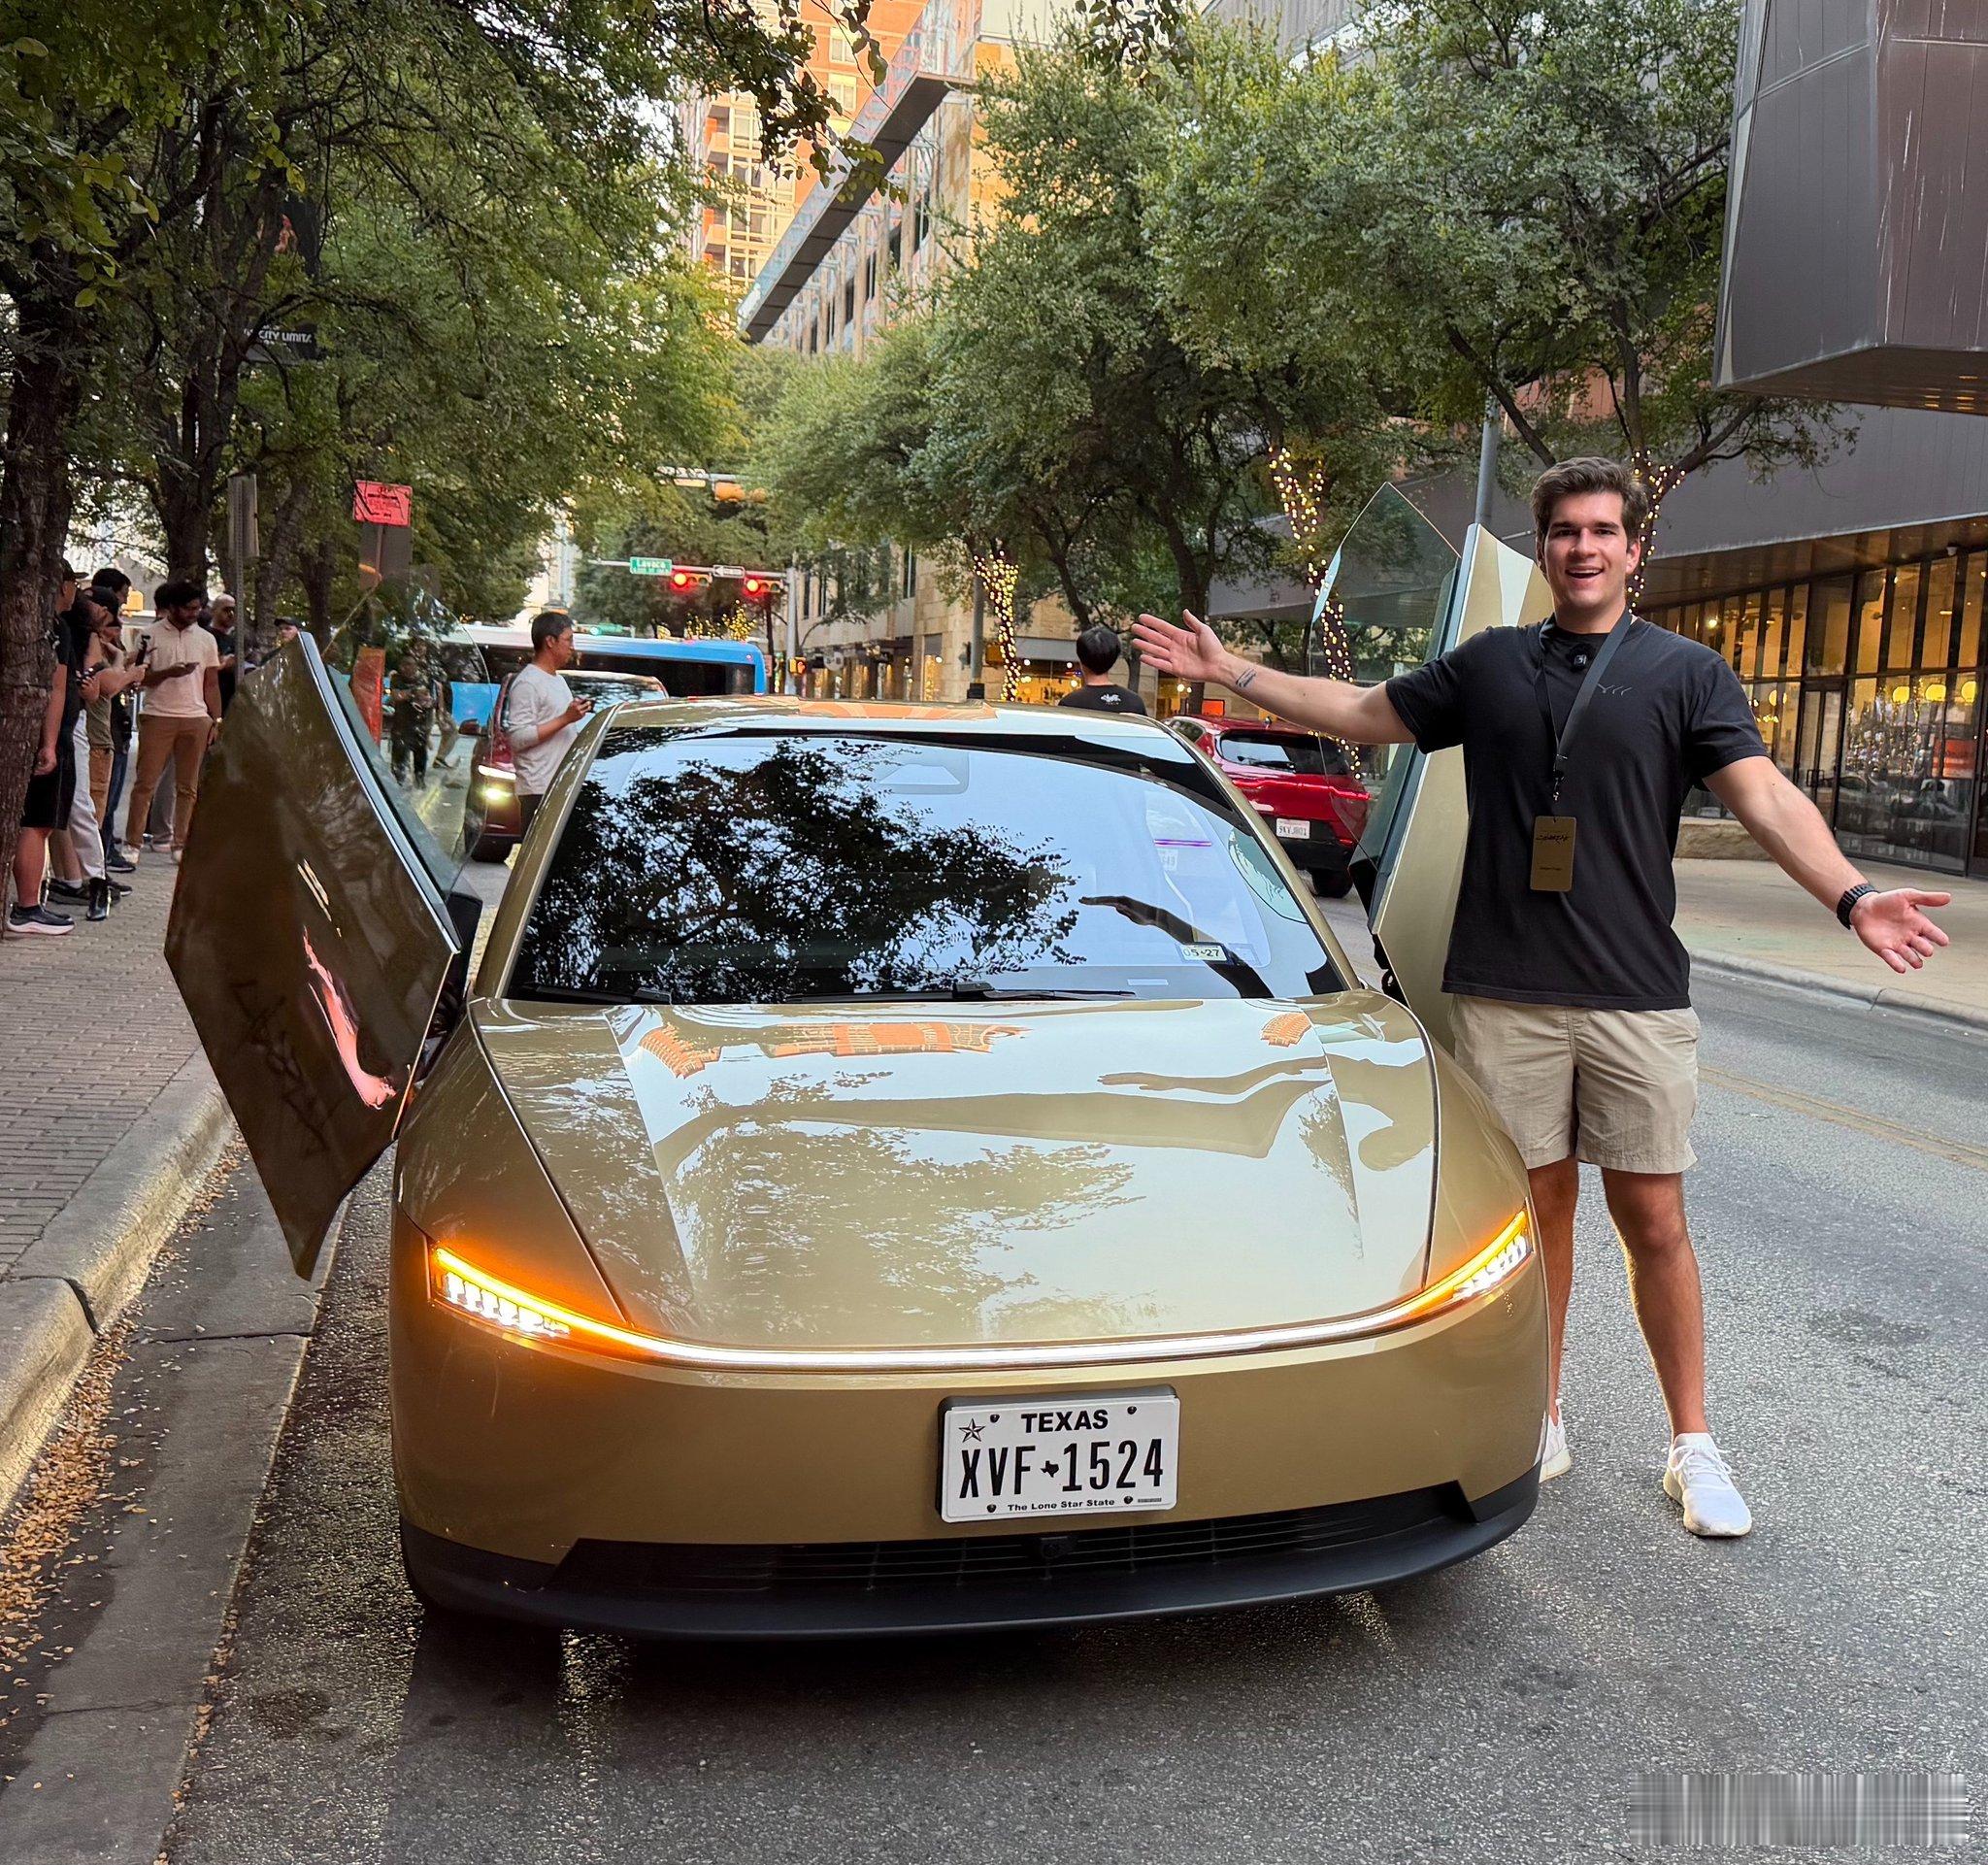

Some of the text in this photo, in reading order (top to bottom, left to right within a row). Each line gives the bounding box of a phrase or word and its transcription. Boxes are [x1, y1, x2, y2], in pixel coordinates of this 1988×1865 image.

[257, 330, 281, 340] CITY
[1020, 1409, 1109, 1434] TEXAS
[1061, 1500, 1083, 1509] Star
[1086, 1498, 1115, 1507] State
